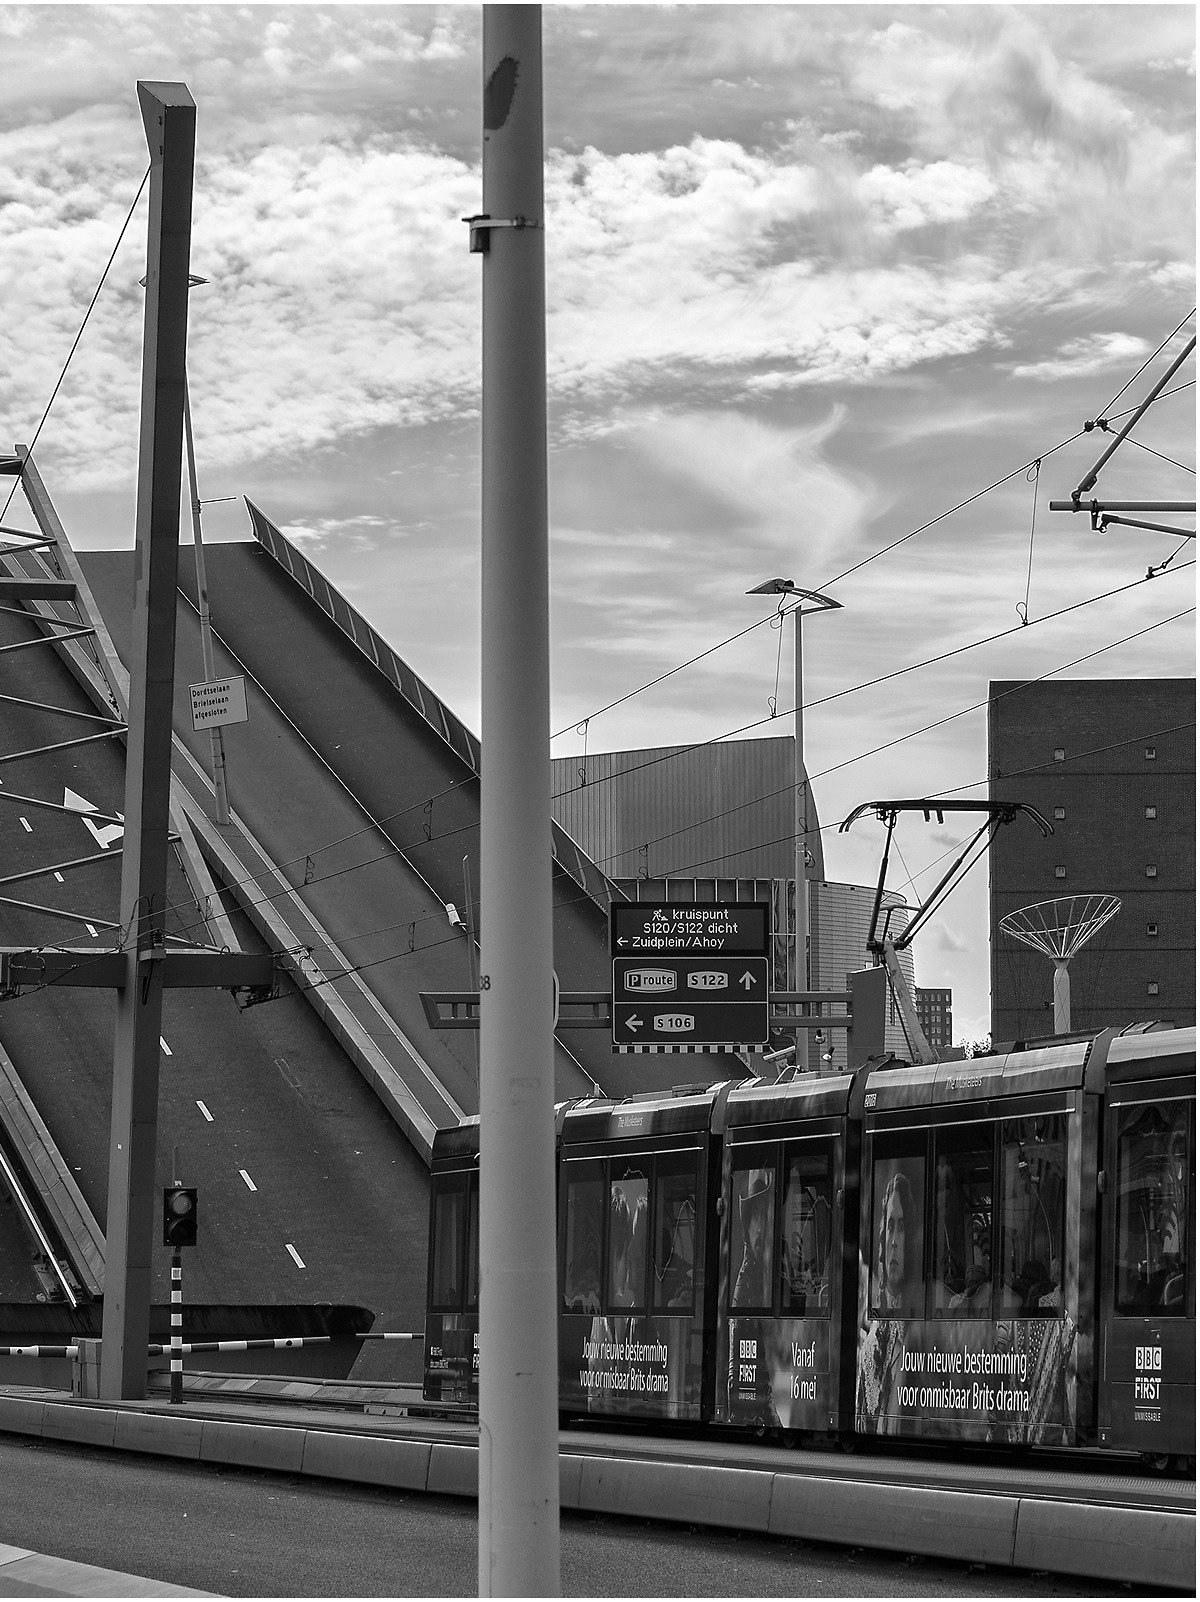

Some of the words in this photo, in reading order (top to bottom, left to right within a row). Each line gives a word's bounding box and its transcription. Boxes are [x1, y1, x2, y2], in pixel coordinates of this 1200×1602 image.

[192, 685, 230, 697] Dordtselaan
[193, 696, 229, 708] Brielselaan
[194, 708, 227, 719] afgesloten
[672, 909, 729, 921] kruispunt
[643, 923, 703, 934] S120/S122
[707, 922, 738, 934] dicht
[632, 936, 725, 949] Zuidplein/Ahoy
[643, 975, 673, 986] route
[701, 975, 725, 986] 122
[667, 1017, 691, 1028] 106
[582, 1336, 600, 1359] Jouw
[625, 1337, 668, 1368] bestemming
[740, 1340, 757, 1358] BBC
[791, 1341, 816, 1367] Vanaf
[900, 1345, 925, 1372] Jouw
[927, 1346, 962, 1373] nieuwe
[964, 1345, 1027, 1382] bestemming
[1135, 1347, 1162, 1370] BBC
[580, 1370, 595, 1387] voor
[630, 1367, 646, 1391] Brits
[646, 1367, 669, 1392] drama
[739, 1364, 757, 1382] FIRST
[790, 1375, 799, 1399] 16
[800, 1375, 817, 1400] mei
[897, 1386, 918, 1407] voor
[920, 1380, 971, 1409] onmisbaar
[972, 1382, 995, 1410] Brits
[996, 1381, 1029, 1411] drama
[1134, 1377, 1161, 1399] FIRST
